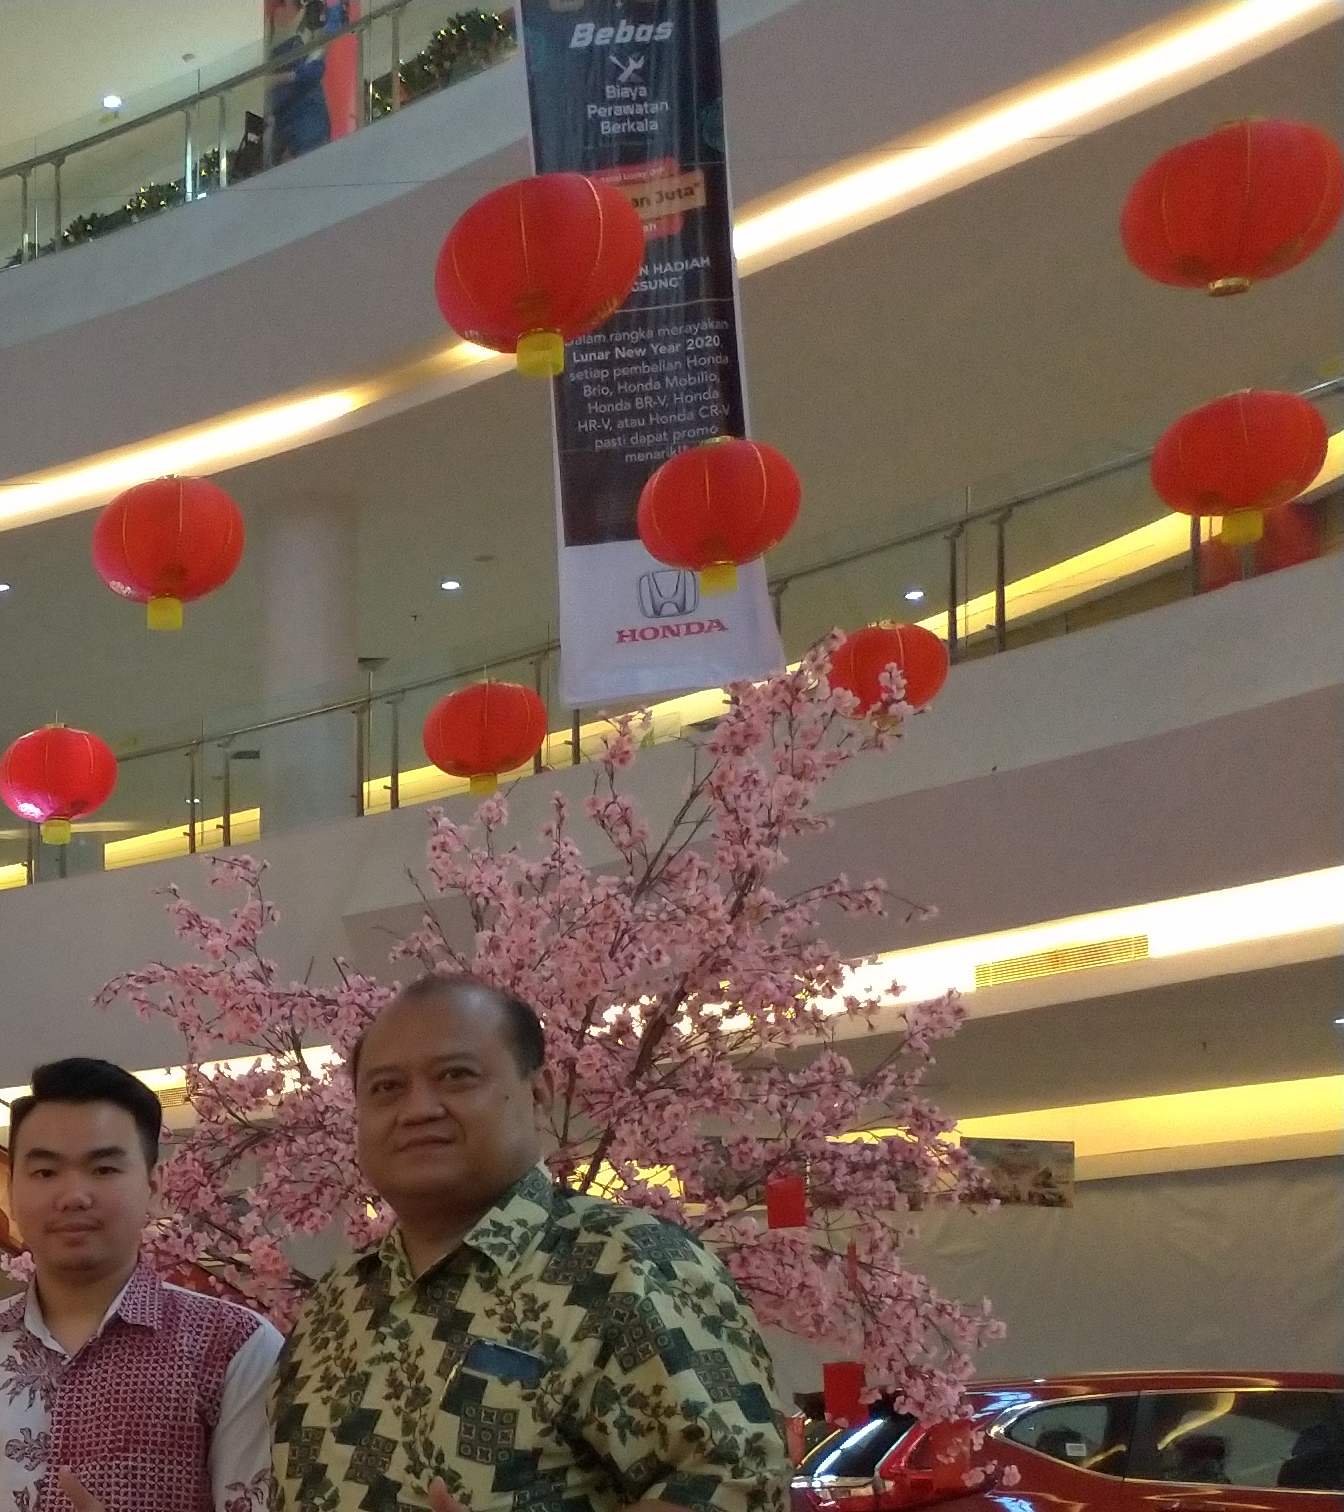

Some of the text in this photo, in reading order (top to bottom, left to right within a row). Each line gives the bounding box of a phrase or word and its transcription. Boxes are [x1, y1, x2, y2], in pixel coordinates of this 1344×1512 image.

[569, 19, 675, 49] Bebas
[605, 84, 648, 102] Biaya
[587, 99, 670, 119] Perawatan
[600, 119, 659, 136] Berkala
[653, 256, 711, 275] HADIAH
[610, 319, 729, 343] rangka merayakan
[573, 351, 611, 363] Lunar
[615, 347, 647, 359] New
[650, 342, 681, 355] Year
[570, 352, 729, 382] setiap pembelian Honda
[583, 372, 720, 398] Brio, Honda Mobilio,
[588, 400, 631, 414] Honda
[674, 389, 719, 405] Honda
[578, 404, 730, 433] HR-V, atau Honda CR-V
[595, 425, 719, 450] pasti dapat promo
[615, 618, 730, 644] HONDA
